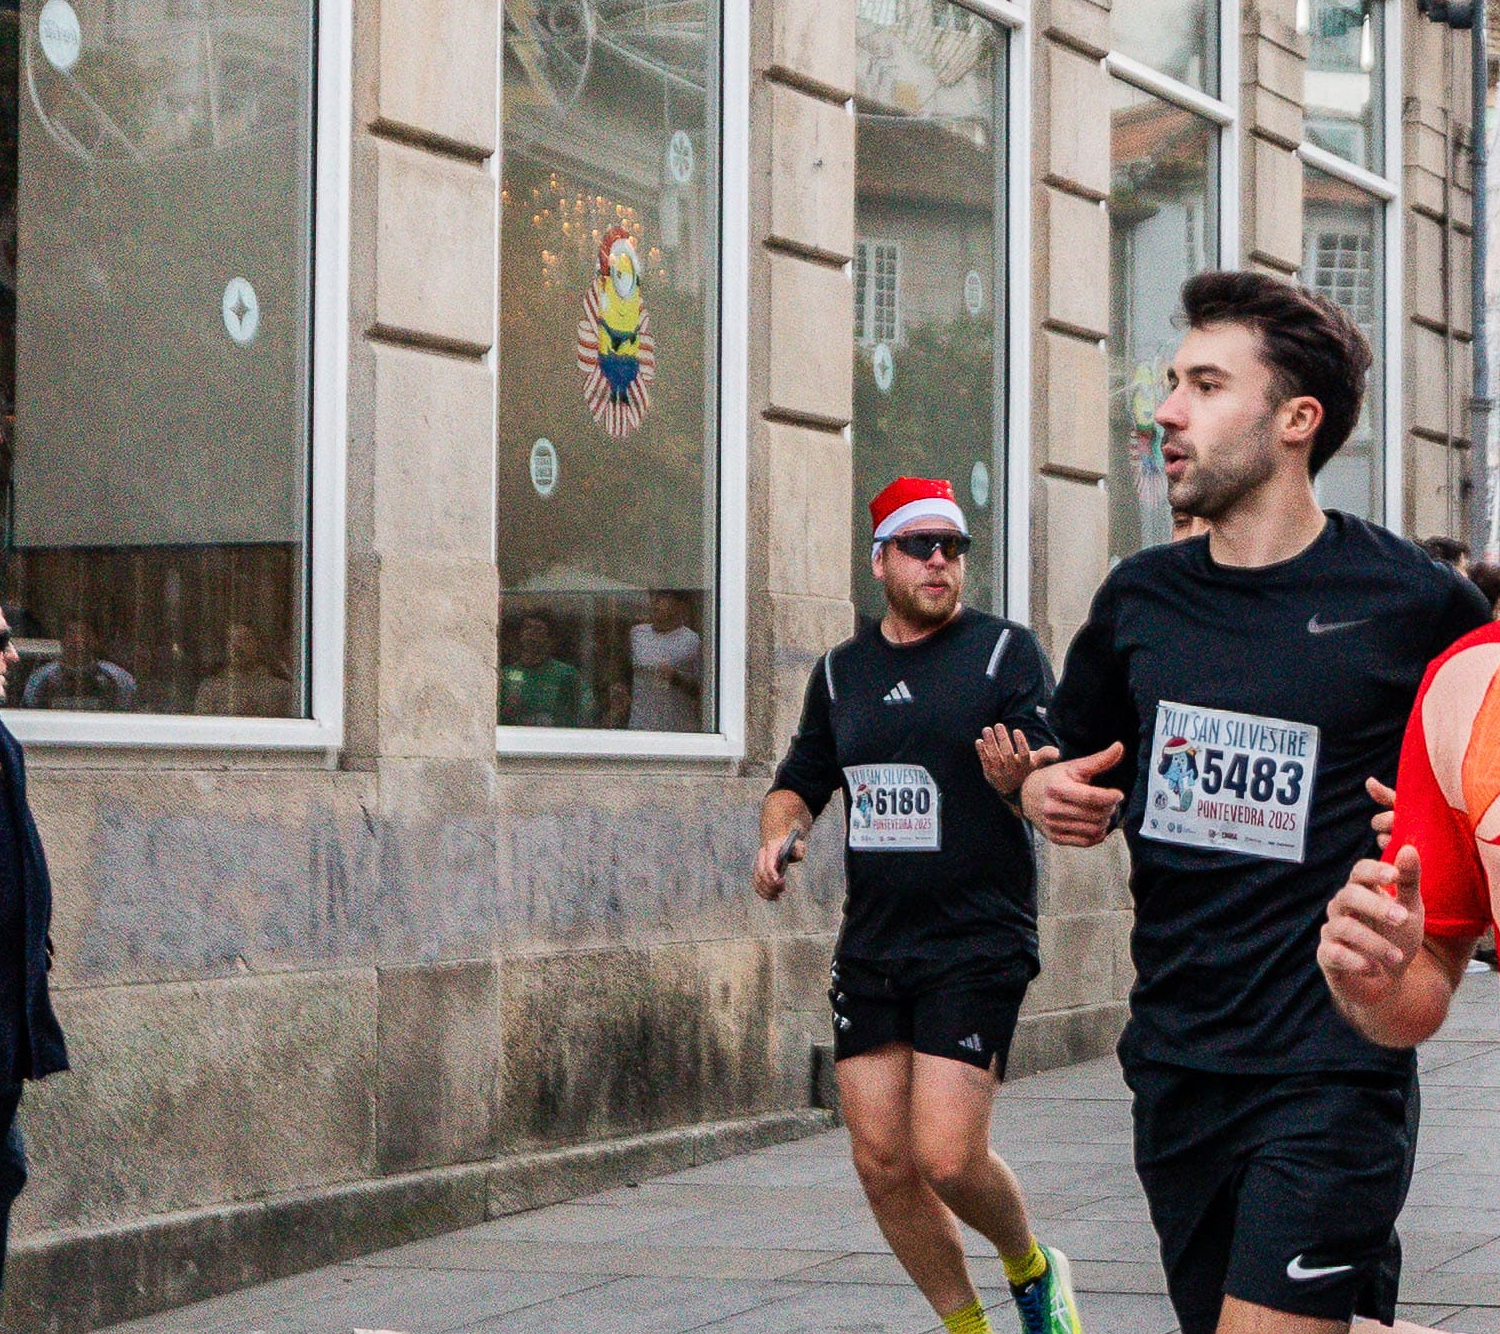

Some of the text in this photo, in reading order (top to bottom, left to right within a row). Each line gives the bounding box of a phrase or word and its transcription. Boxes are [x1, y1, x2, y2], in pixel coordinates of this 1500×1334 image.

[1161, 709, 1308, 757] XLII SAN SILVESTRE
[882, 768, 931, 785] SILVESTRE
[1200, 748, 1305, 806] 5483
[875, 787, 931, 816] 6180
[1197, 799, 1297, 831] PONTEVEDRA 2025
[873, 818, 932, 831] PONTEVEDRA 2025
